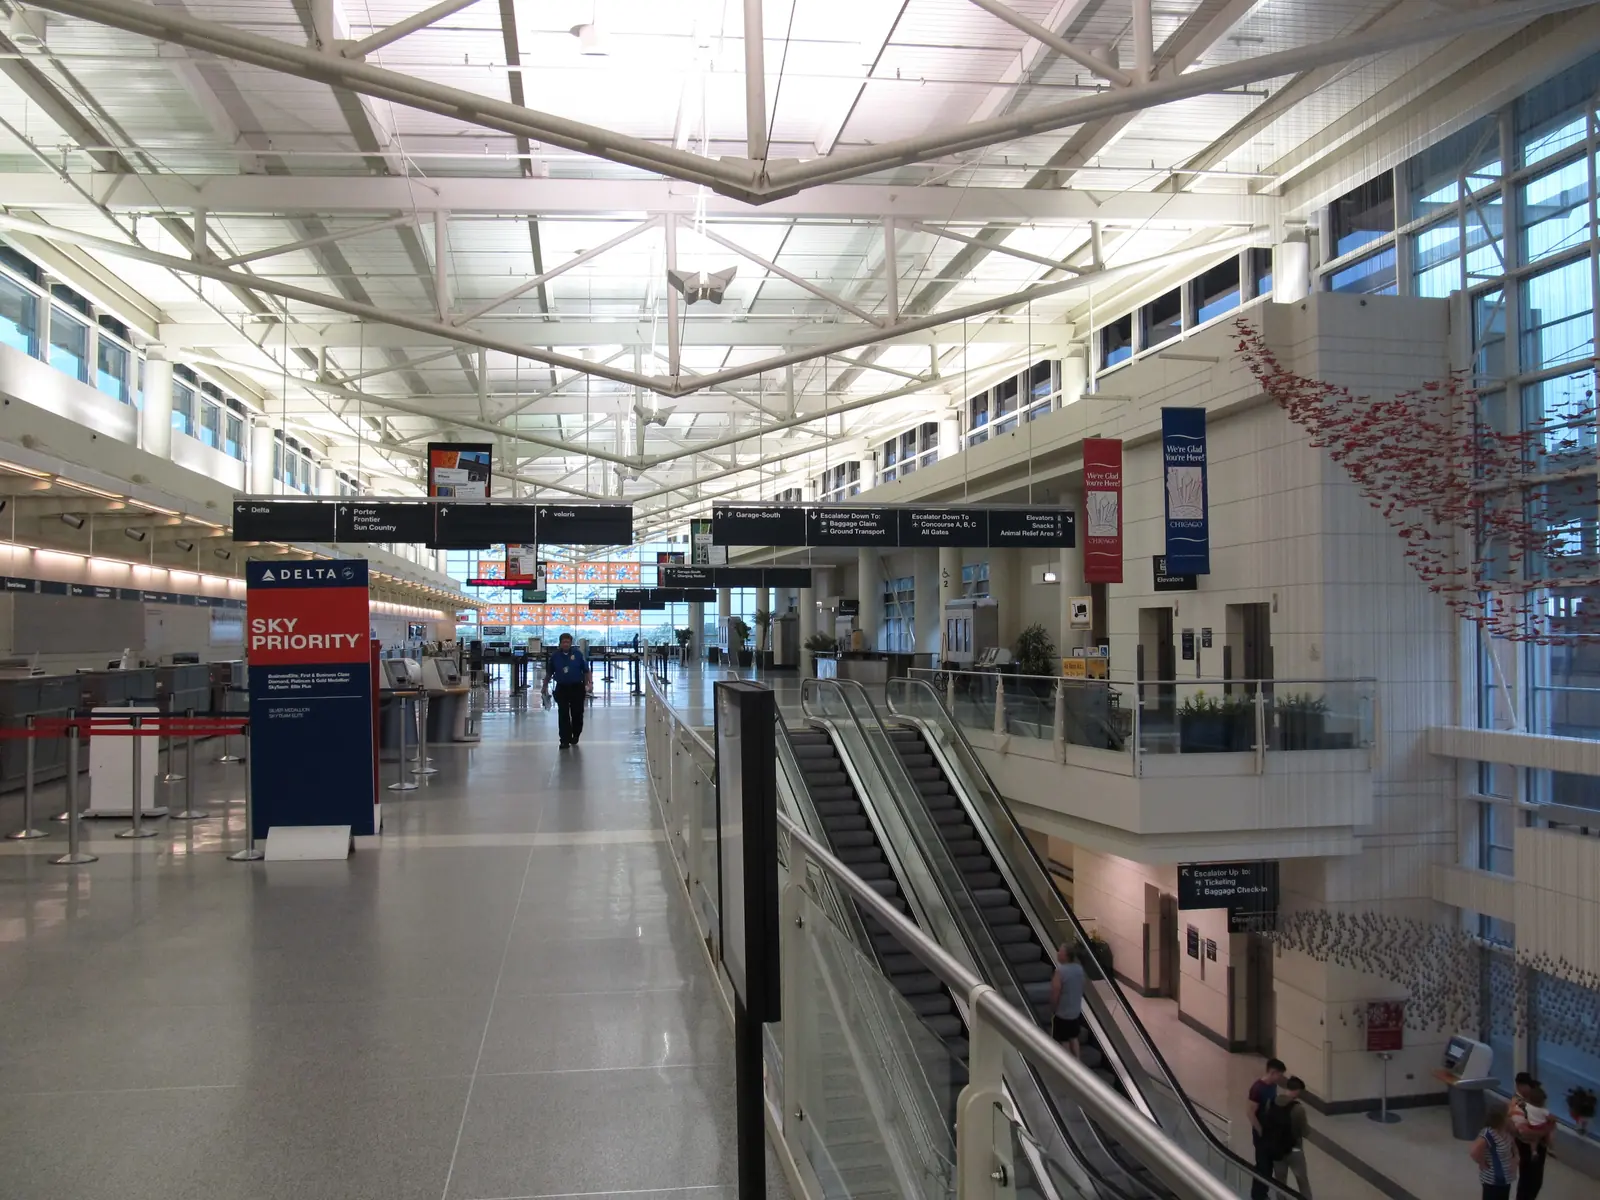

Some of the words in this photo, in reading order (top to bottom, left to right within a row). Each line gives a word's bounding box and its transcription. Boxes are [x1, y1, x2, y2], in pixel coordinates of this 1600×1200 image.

[736, 511, 781, 519] Garage-South
[368, 524, 397, 532] Country
[829, 520, 857, 528] Baggage
[280, 569, 337, 579] DELTA
[252, 618, 298, 633] SKY
[1193, 869, 1227, 877] Escalator
[1204, 888, 1235, 896] Baggage
